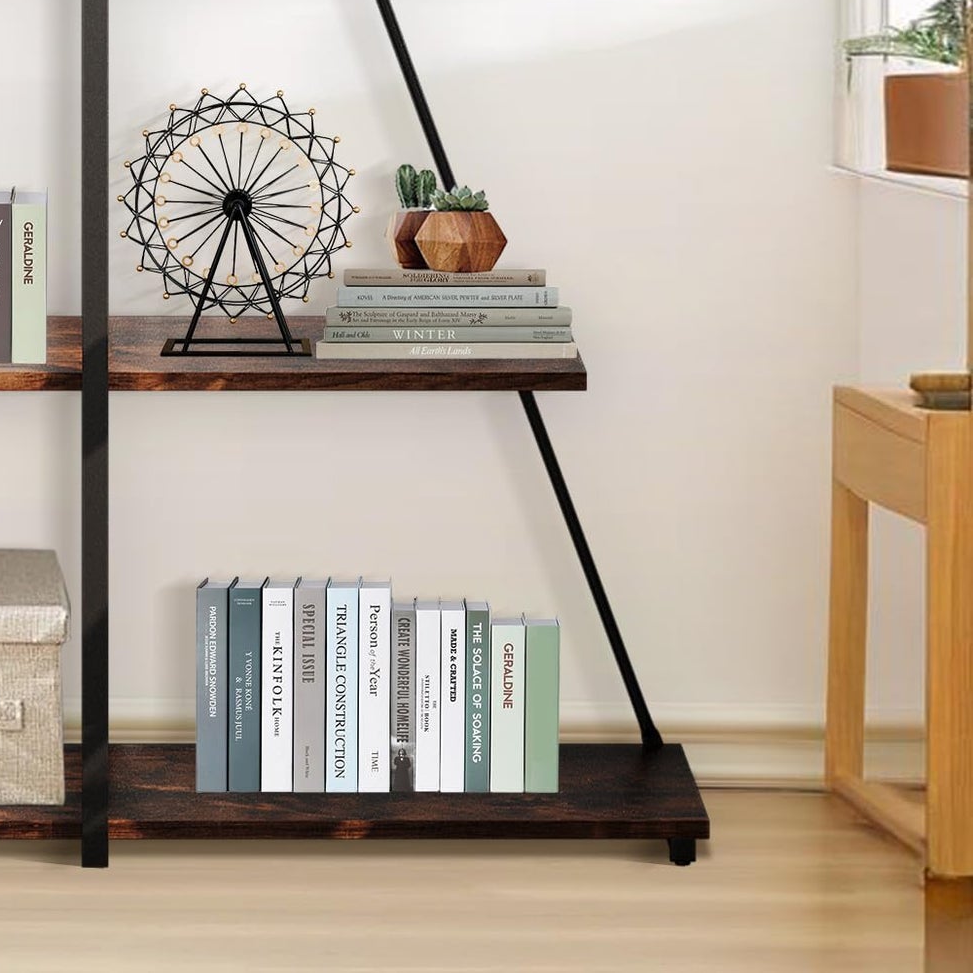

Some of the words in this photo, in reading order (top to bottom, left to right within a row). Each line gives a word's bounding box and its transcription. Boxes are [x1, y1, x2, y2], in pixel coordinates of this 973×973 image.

[24, 222, 34, 284] GERALDINE
[392, 330, 456, 340] WINTER
[410, 346, 420, 355] All
[302, 604, 316, 648] SPECIAL
[336, 604, 348, 672] TRIANGLE
[370, 604, 380, 648] Person
[398, 617, 411, 646] CREATE
[472, 622, 482, 643] THE
[302, 654, 316, 684] ISSUE
[370, 649, 376, 658] of
[397, 649, 410, 699] WONDERFUL
[472, 648, 482, 690] SOLACE
[272, 646, 282, 716] KINFOLK
[370, 668, 380, 696] Year
[503, 643, 514, 709] GERALDINE
[472, 694, 482, 708] OF
[334, 676, 346, 778] CONSTRUCTION
[396, 702, 409, 743] HOMELIFE
[472, 713, 482, 763] SOAKING
